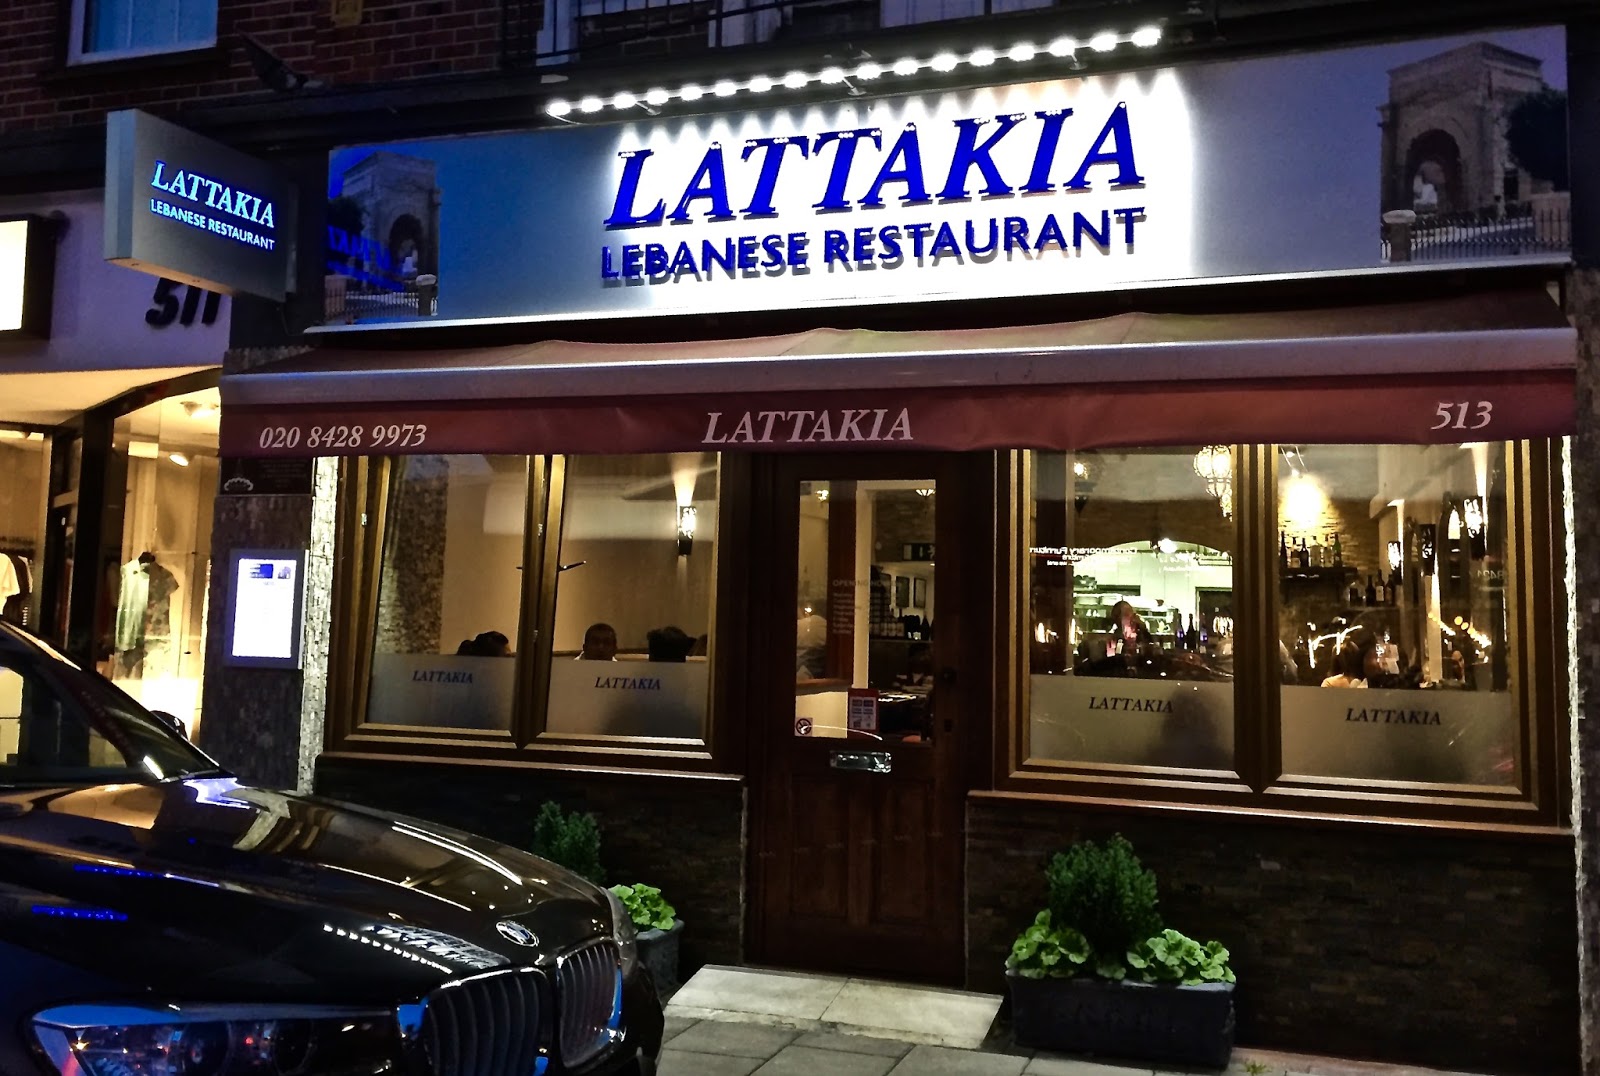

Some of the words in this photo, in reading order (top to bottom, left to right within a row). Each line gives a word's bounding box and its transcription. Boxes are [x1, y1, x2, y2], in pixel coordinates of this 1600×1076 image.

[603, 100, 1147, 229] LATTAKIA
[151, 161, 275, 229] LATTAKIA
[150, 198, 206, 229] LEBANESE
[207, 218, 276, 251] RESTAURANT
[601, 232, 808, 282] LEBANESE
[823, 207, 1147, 266] RESTAURANT
[701, 407, 914, 444] LATTAKIA
[1430, 400, 1493, 430] 513
[258, 426, 302, 449] 020
[306, 425, 364, 448] 8428
[368, 423, 427, 448] 9973
[411, 669, 474, 684] LATTAKIA
[594, 676, 661, 690] LATTAKIA
[1088, 696, 1174, 714] LATTAKIA
[1344, 707, 1441, 726] LATTAKIA
